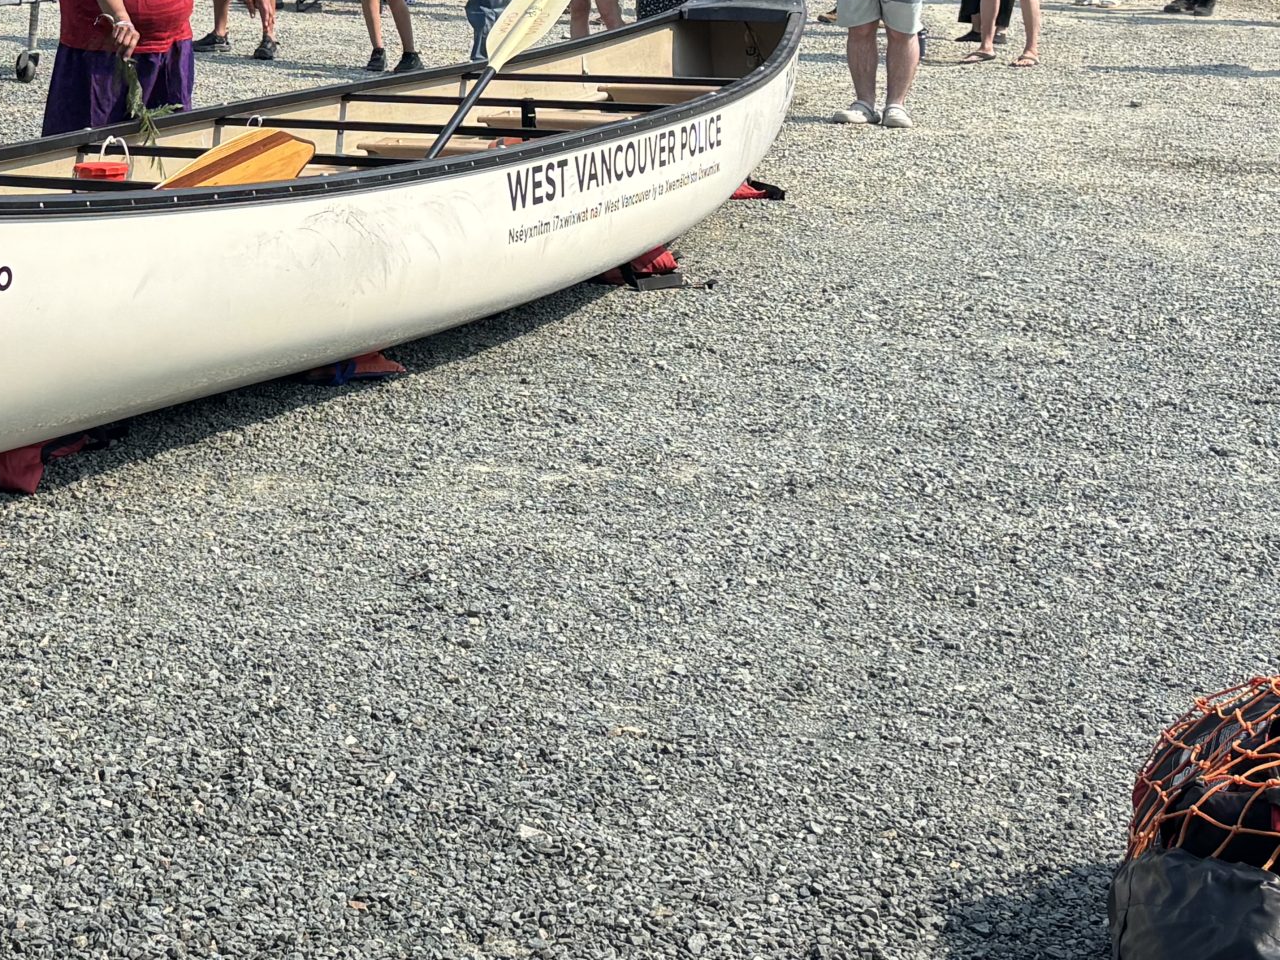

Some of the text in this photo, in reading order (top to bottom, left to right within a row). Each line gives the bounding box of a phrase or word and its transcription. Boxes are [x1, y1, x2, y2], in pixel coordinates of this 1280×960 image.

[506, 114, 722, 211] WEST VANCOUVER POLICE
[604, 197, 620, 215] West
[621, 189, 652, 209] Vancouver
